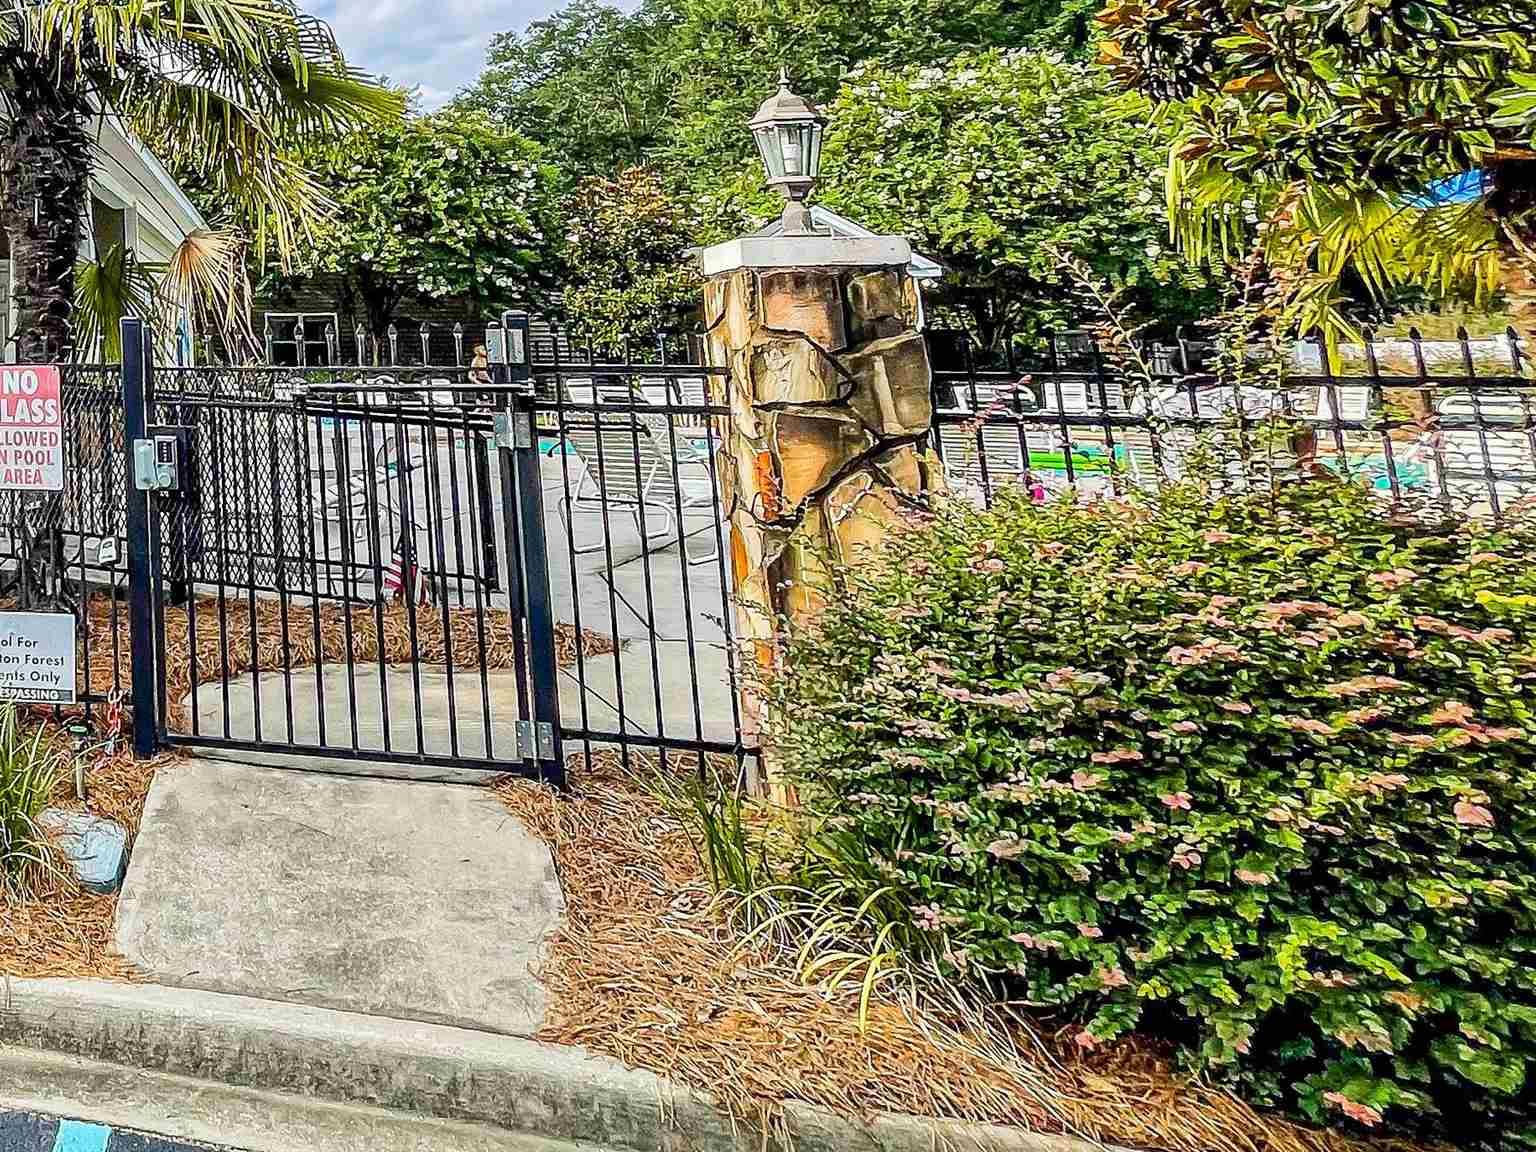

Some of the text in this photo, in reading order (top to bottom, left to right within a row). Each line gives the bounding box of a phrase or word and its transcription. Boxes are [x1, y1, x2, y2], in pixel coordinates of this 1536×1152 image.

[2, 369, 38, 395] NO
[15, 450, 55, 466] POOL
[4, 468, 43, 484] AREA
[17, 636, 39, 648] For
[25, 654, 64, 666] Forest
[30, 670, 61, 685] Only
